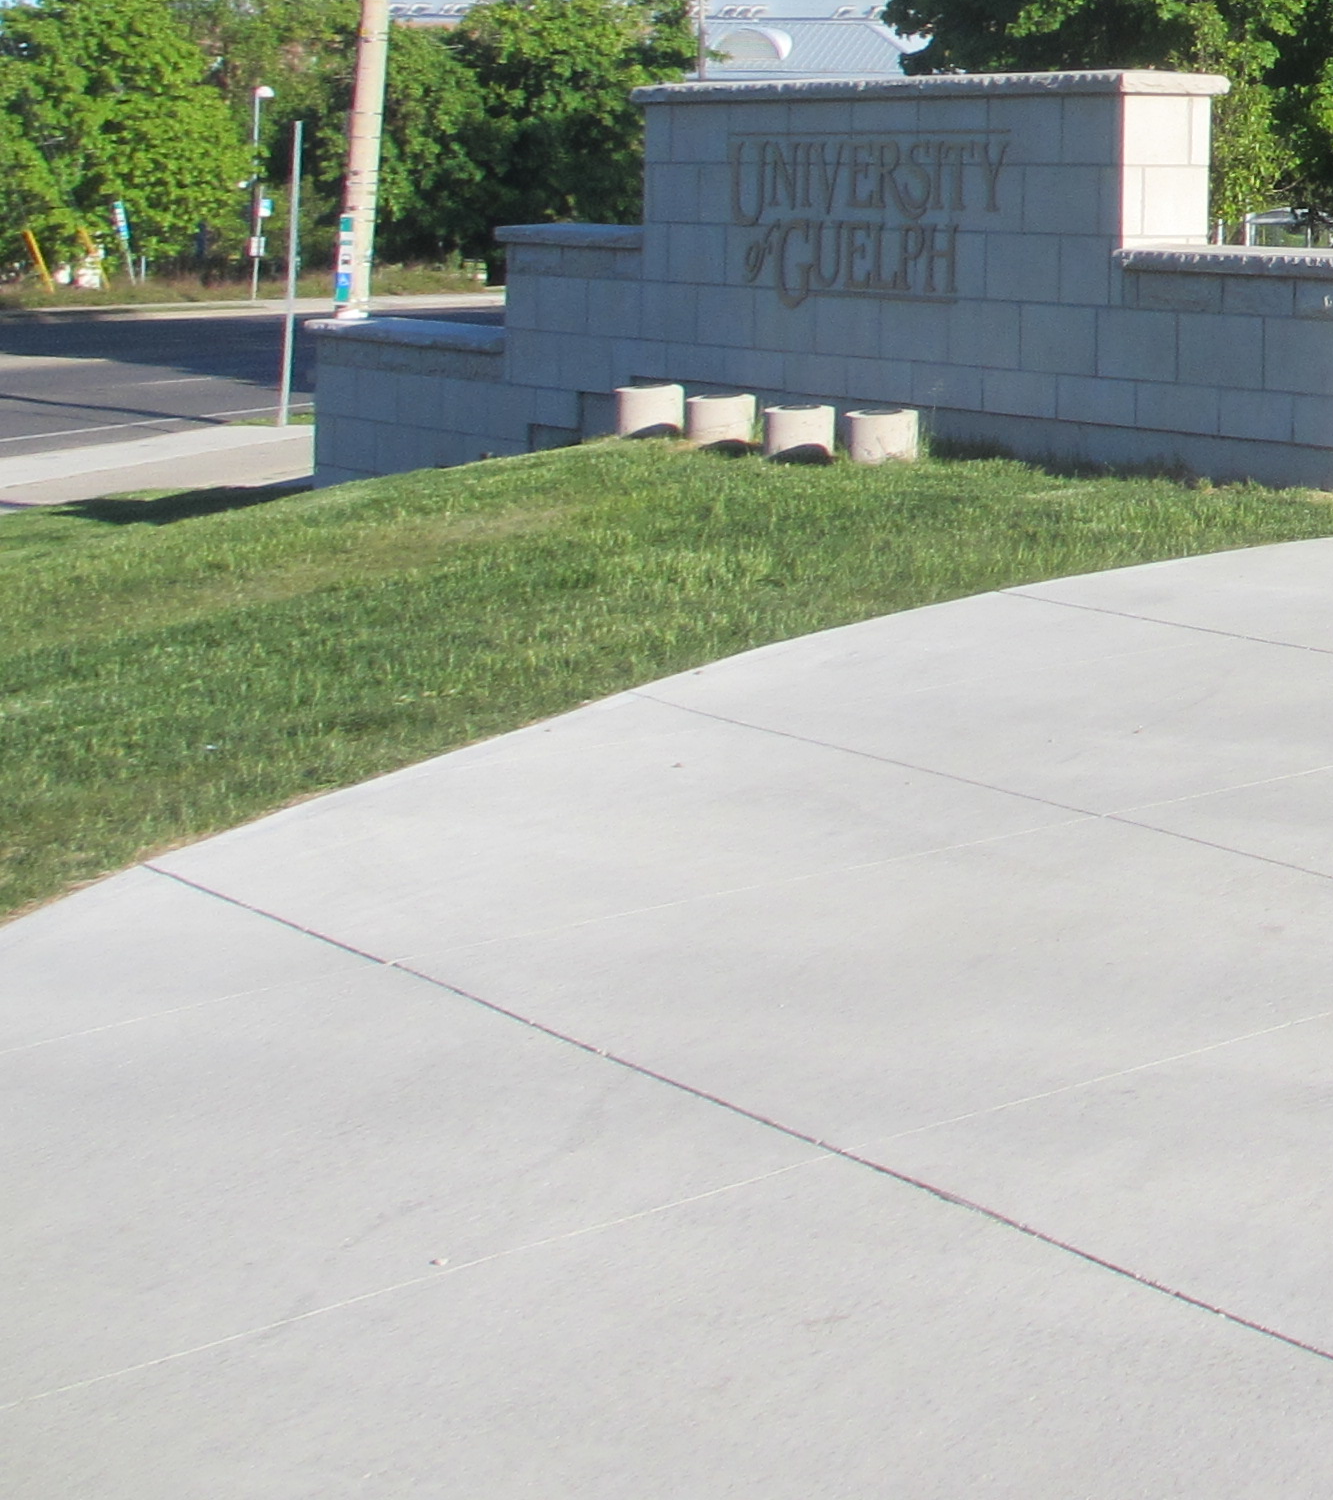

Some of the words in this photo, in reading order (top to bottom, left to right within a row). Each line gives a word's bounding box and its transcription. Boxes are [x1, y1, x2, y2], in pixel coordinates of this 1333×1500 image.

[729, 140, 1009, 227] UNIVERSITY
[743, 219, 781, 284] of
[775, 217, 959, 310] GUELPH
